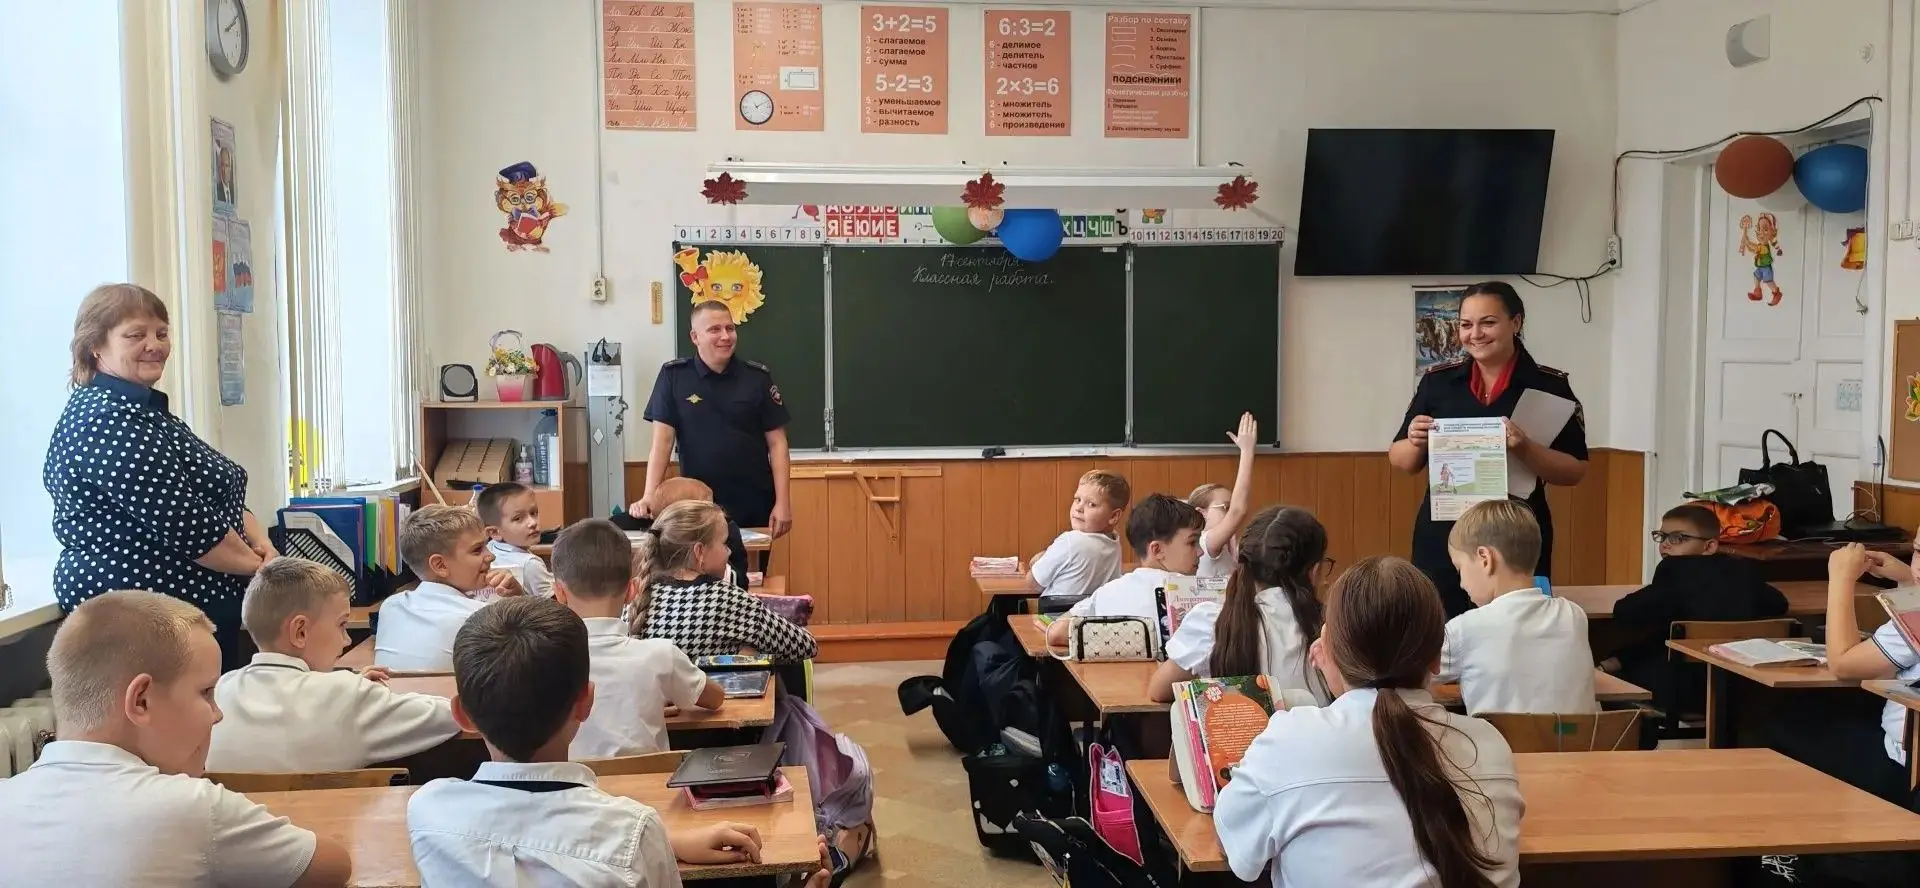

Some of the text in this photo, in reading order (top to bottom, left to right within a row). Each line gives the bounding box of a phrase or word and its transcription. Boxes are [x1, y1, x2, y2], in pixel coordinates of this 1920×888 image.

[872, 13, 936, 33] 3+2=5
[1108, 16, 1139, 24] Разбор
[1154, 17, 1188, 25] составу
[999, 18, 1056, 36] 6:3=2
[879, 58, 907, 66] сумма
[875, 73, 933, 93] 5-2=3
[1113, 76, 1181, 84] подснежники
[879, 118, 920, 126] разность
[680, 229, 821, 239] 0 1 2 3 4 5 6 7 8 9
[1132, 231, 1283, 240] 10 11 12 13 14 15 16 17 18 19 20
[913, 264, 982, 285] Классная
